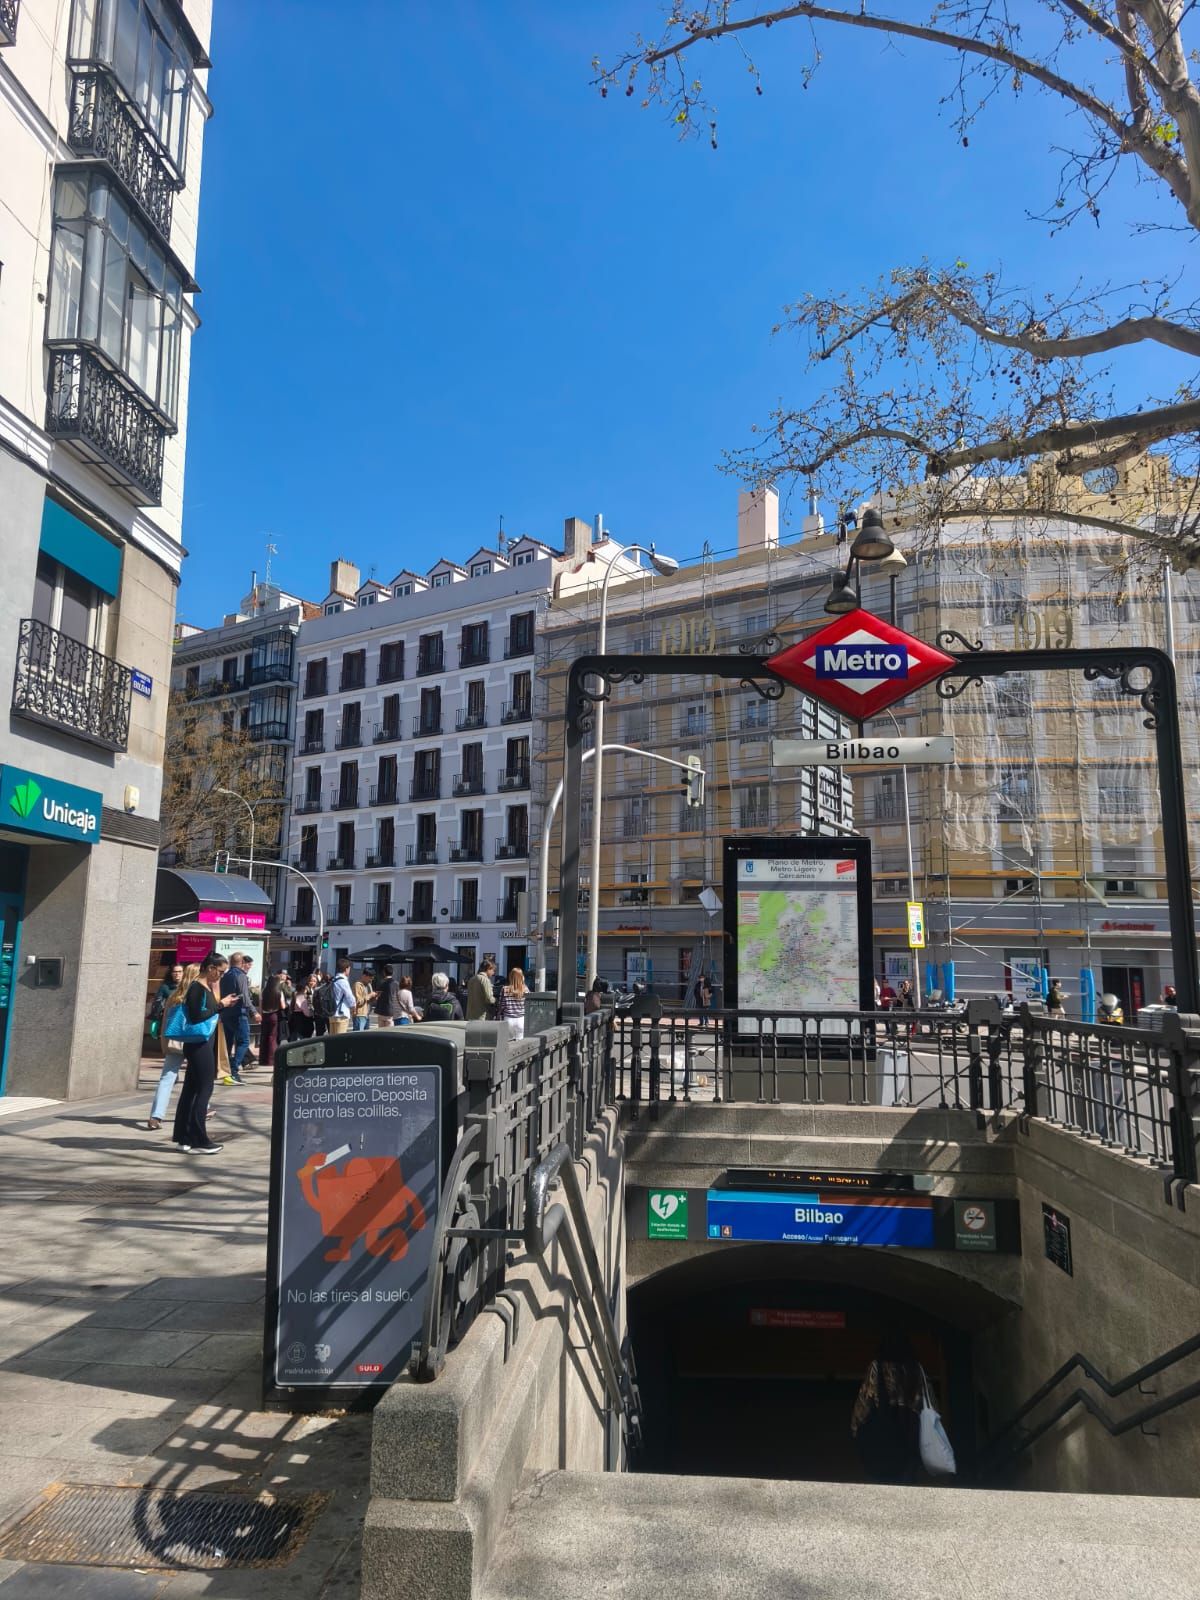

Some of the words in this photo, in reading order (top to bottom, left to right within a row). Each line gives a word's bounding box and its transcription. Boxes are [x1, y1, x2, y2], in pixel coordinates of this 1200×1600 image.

[1012, 610, 1073, 650] 1919
[823, 649, 901, 672] Metro
[826, 743, 900, 760] Bilbao
[43, 797, 97, 834] Unicaja
[793, 866, 817, 874] Ligero
[294, 1075, 327, 1088] Cada
[330, 1074, 384, 1090] papelera
[387, 1073, 418, 1086] tiene
[293, 1093, 309, 1104] su
[311, 1090, 368, 1103] cenicero.
[371, 1088, 427, 1104] Deposita
[293, 1106, 334, 1119] dentro
[337, 1105, 355, 1118] las
[357, 1104, 402, 1118] colillas.
[794, 1208, 844, 1224] Bilbao
[723, 1226, 730, 1236] 4
[287, 1289, 307, 1303] No
[309, 1288, 328, 1303] las
[331, 1289, 359, 1302] tires
[361, 1287, 372, 1302] al
[375, 1287, 413, 1302] suelo.
[358, 1364, 380, 1372] SULO
